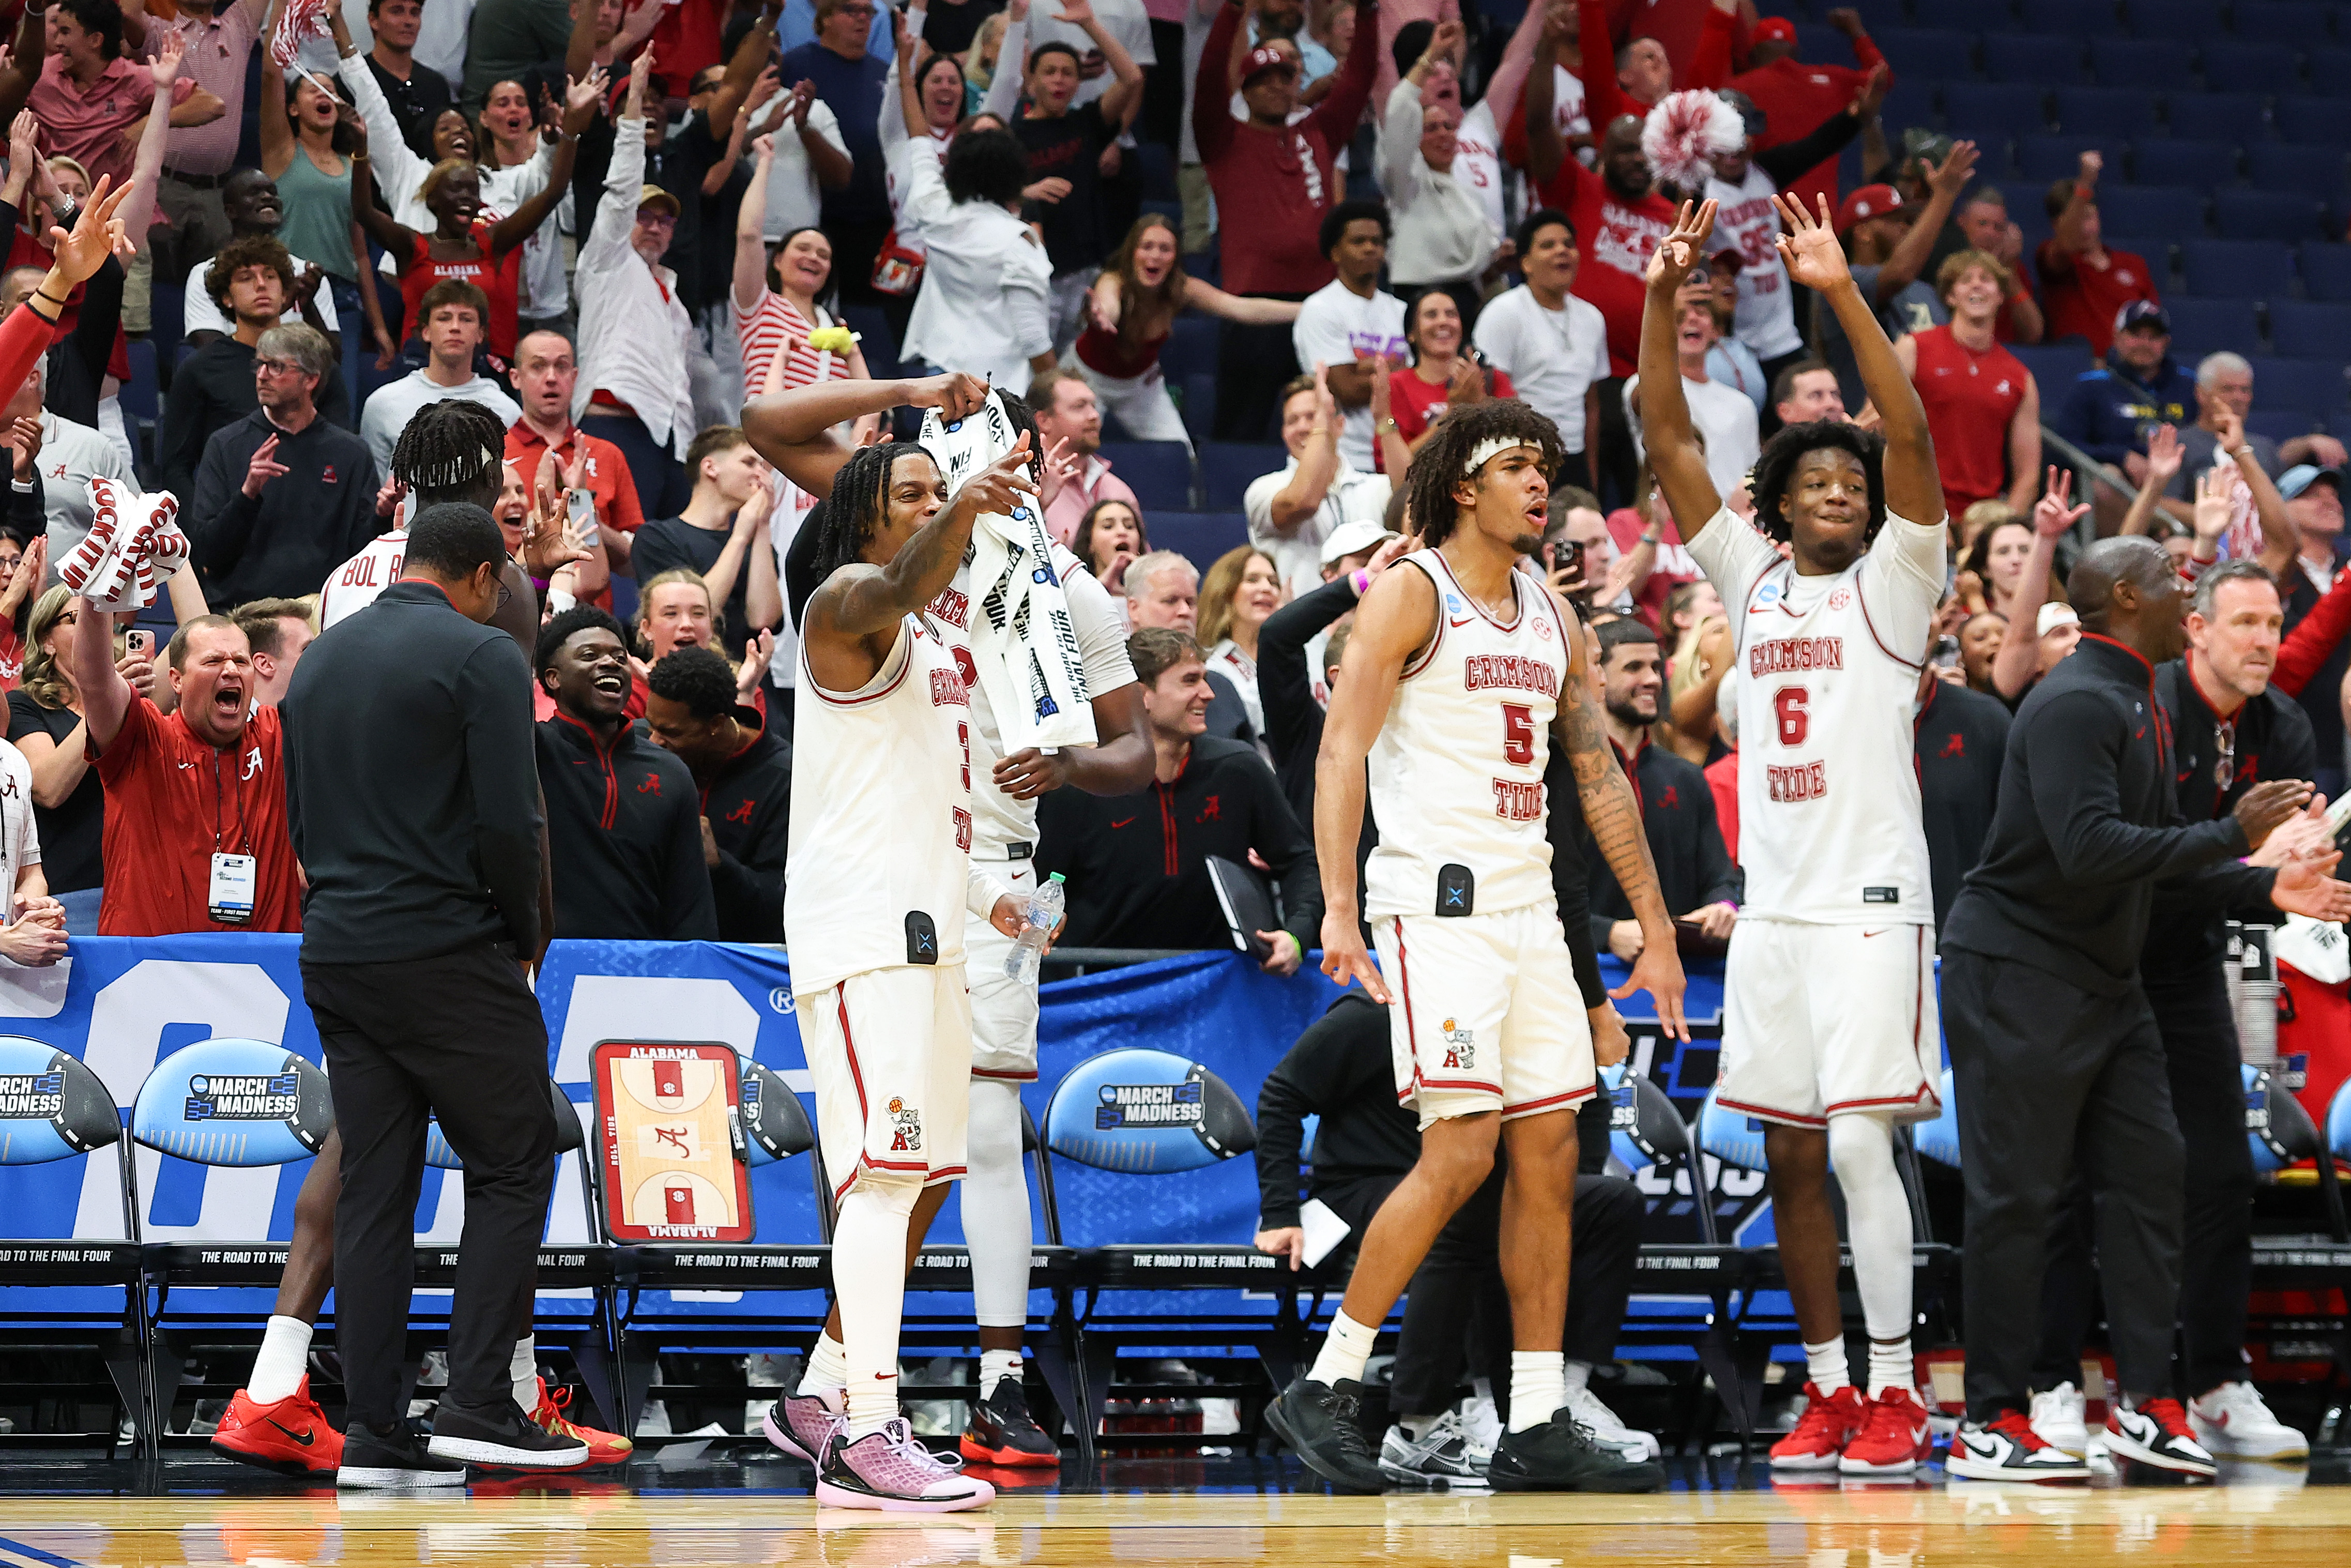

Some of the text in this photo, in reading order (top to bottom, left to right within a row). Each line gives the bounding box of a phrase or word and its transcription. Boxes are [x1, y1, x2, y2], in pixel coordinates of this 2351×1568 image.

[434, 264, 482, 276] ALABAMA
[91, 478, 118, 545] LOCK
[341, 556, 377, 587] BOL
[1047, 610, 1084, 704] THE ROAD TO THE
[1750, 636, 1843, 679] CRIMSON
[1464, 654, 1560, 701] CRIMSON
[1774, 684, 1811, 749] 6
[1500, 701, 1536, 767] 5
[1767, 759, 1827, 802] TIDE
[630, 1047, 699, 1060] ALABAMA
[0, 1077, 33, 1094] RCH
[208, 1078, 268, 1095] MARCH
[216, 1095, 297, 1114] MADNESS
[1116, 1087, 1173, 1105] MARCH
[1124, 1103, 1202, 1122] MADNESS
[606, 1116, 619, 1166] ROLL TIDE
[648, 1226, 718, 1239] ALABAMA
[13, 1251, 27, 1261] TO
[29, 1251, 50, 1261] THE
[51, 1250, 81, 1262] FINAL
[83, 1250, 112, 1262] FOUR
[201, 1252, 289, 1264] THE ROAD TO THE
[439, 1254, 458, 1266] THE
[558, 1255, 586, 1267] FOUR
[674, 1255, 820, 1268] THE ROAD TO THE FINAL FOUR
[926, 1255, 954, 1267] ROAD
[955, 1255, 969, 1267] TO
[1132, 1254, 1276, 1269] THE ROAD TO THE FINAL FOUR
